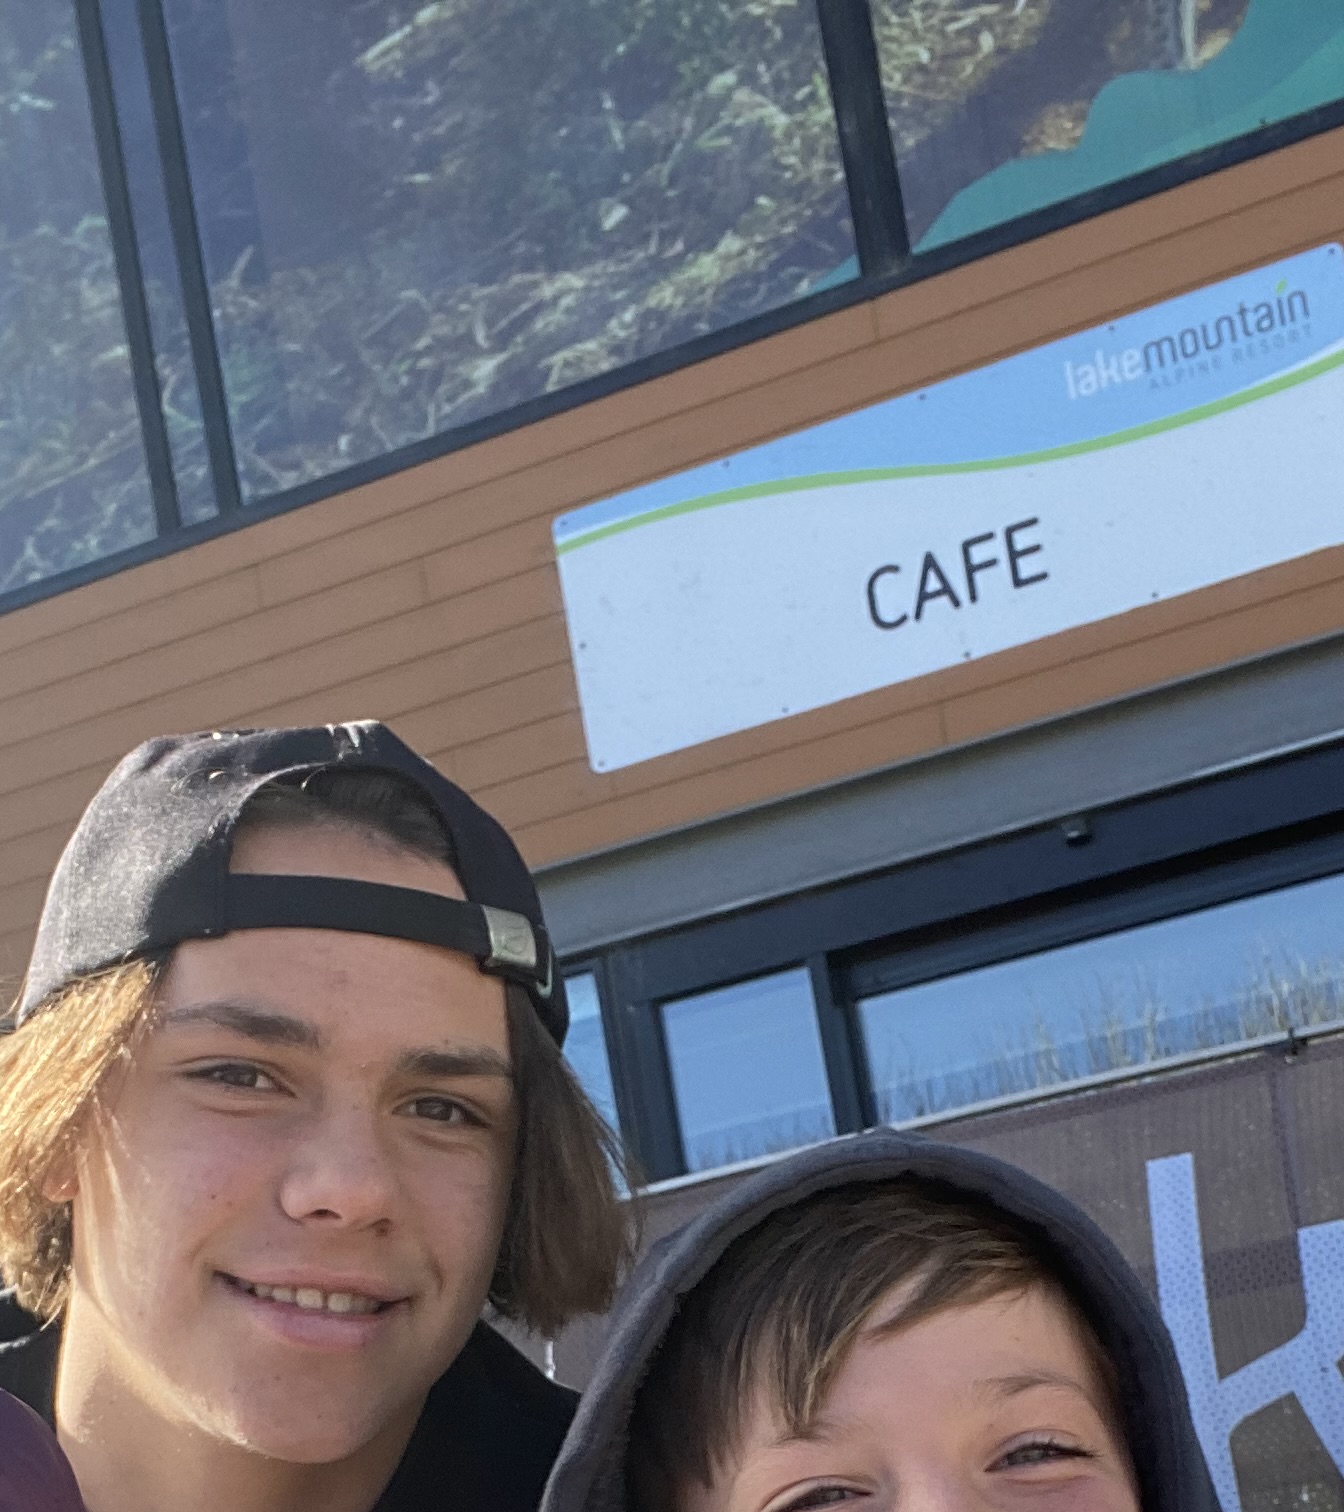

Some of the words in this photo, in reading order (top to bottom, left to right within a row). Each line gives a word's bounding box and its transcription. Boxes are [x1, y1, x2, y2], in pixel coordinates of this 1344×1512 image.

[1148, 354, 1225, 390] ALPINE
[1230, 323, 1314, 363] RESORT
[866, 516, 1049, 629] CAFE
